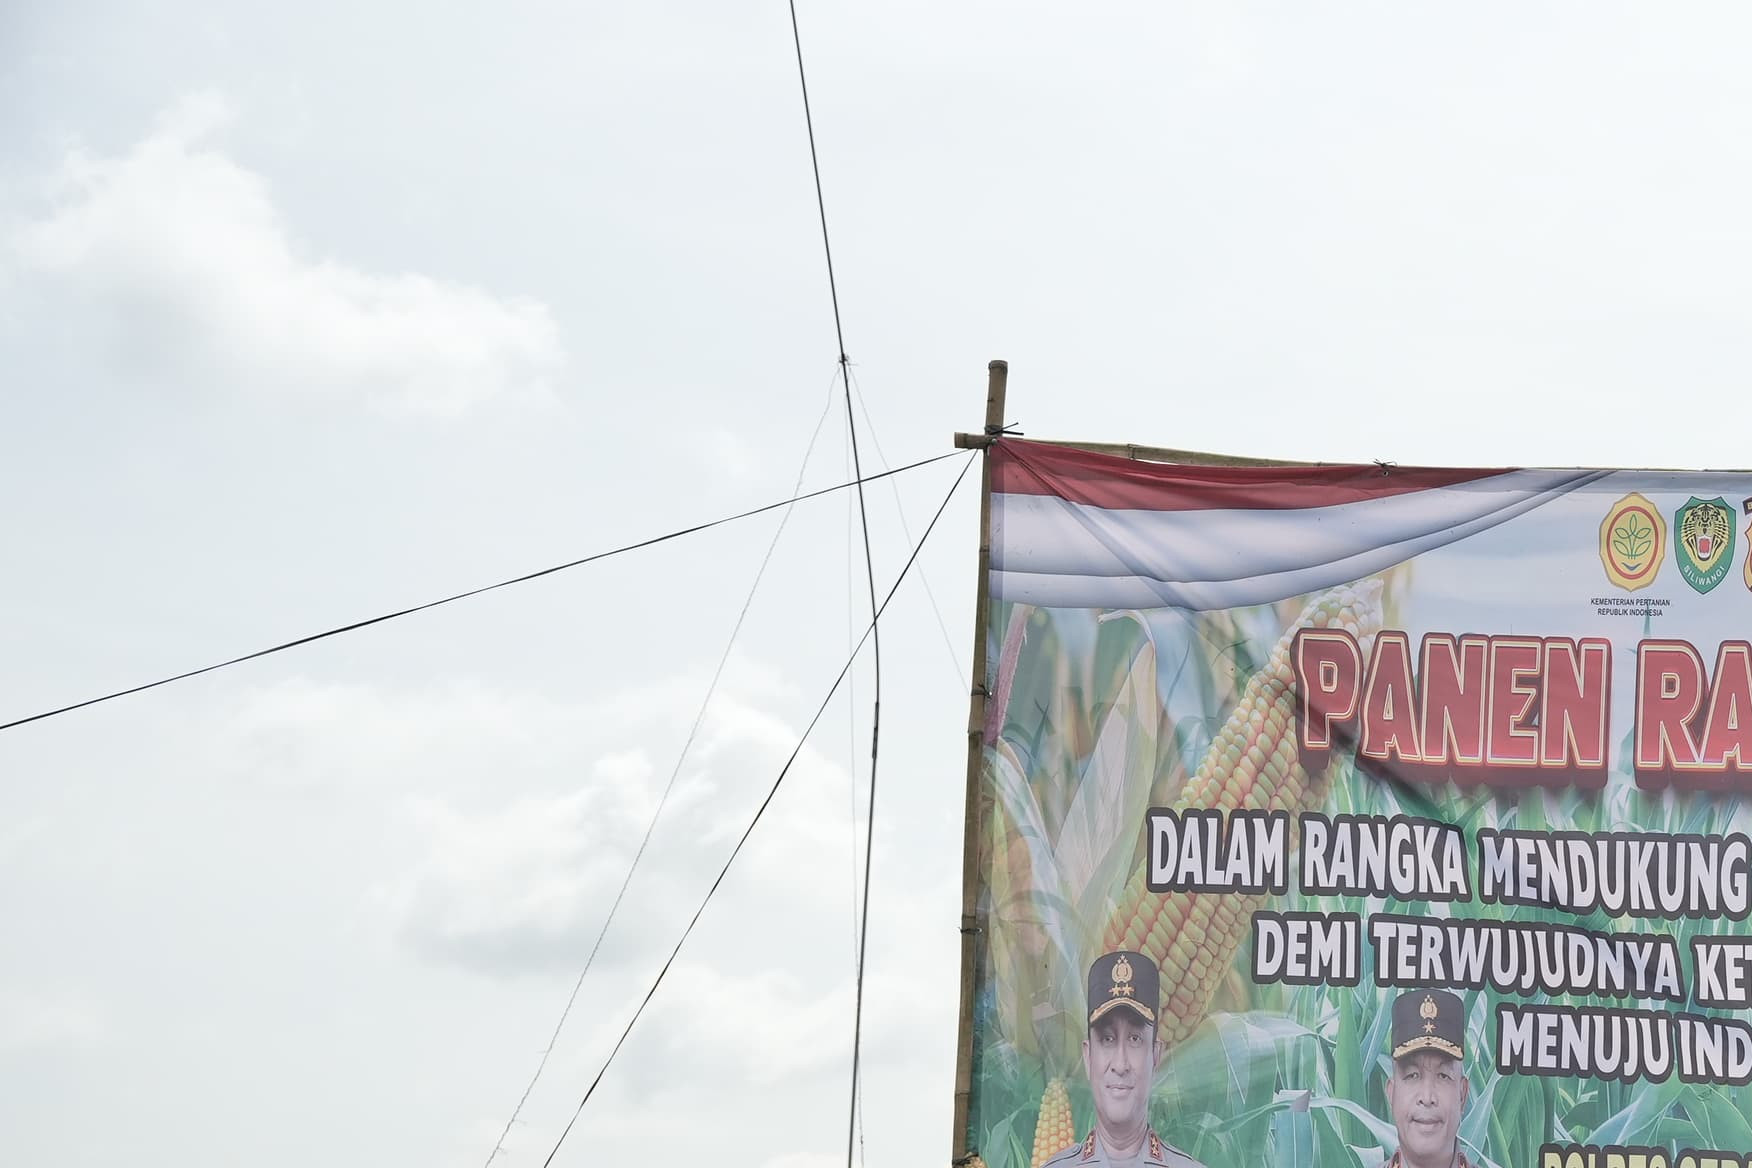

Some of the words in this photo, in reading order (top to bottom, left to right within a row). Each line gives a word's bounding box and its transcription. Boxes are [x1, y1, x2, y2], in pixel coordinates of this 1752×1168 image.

[1590, 598, 1634, 606] KEMENTERIAN
[1684, 565, 1726, 586] SILIWANGI
[1597, 608, 1628, 616] REPUBLIK
[1296, 630, 1610, 778] PANEN
[1150, 815, 1284, 887] DALAM
[1304, 820, 1467, 894] RANGKA
[1483, 836, 1748, 913] MENDUKUNG
[1256, 918, 1356, 980] DEMI
[1373, 919, 1681, 998] TERWUJUDNYA
[1500, 1010, 1669, 1076] MENUJU
